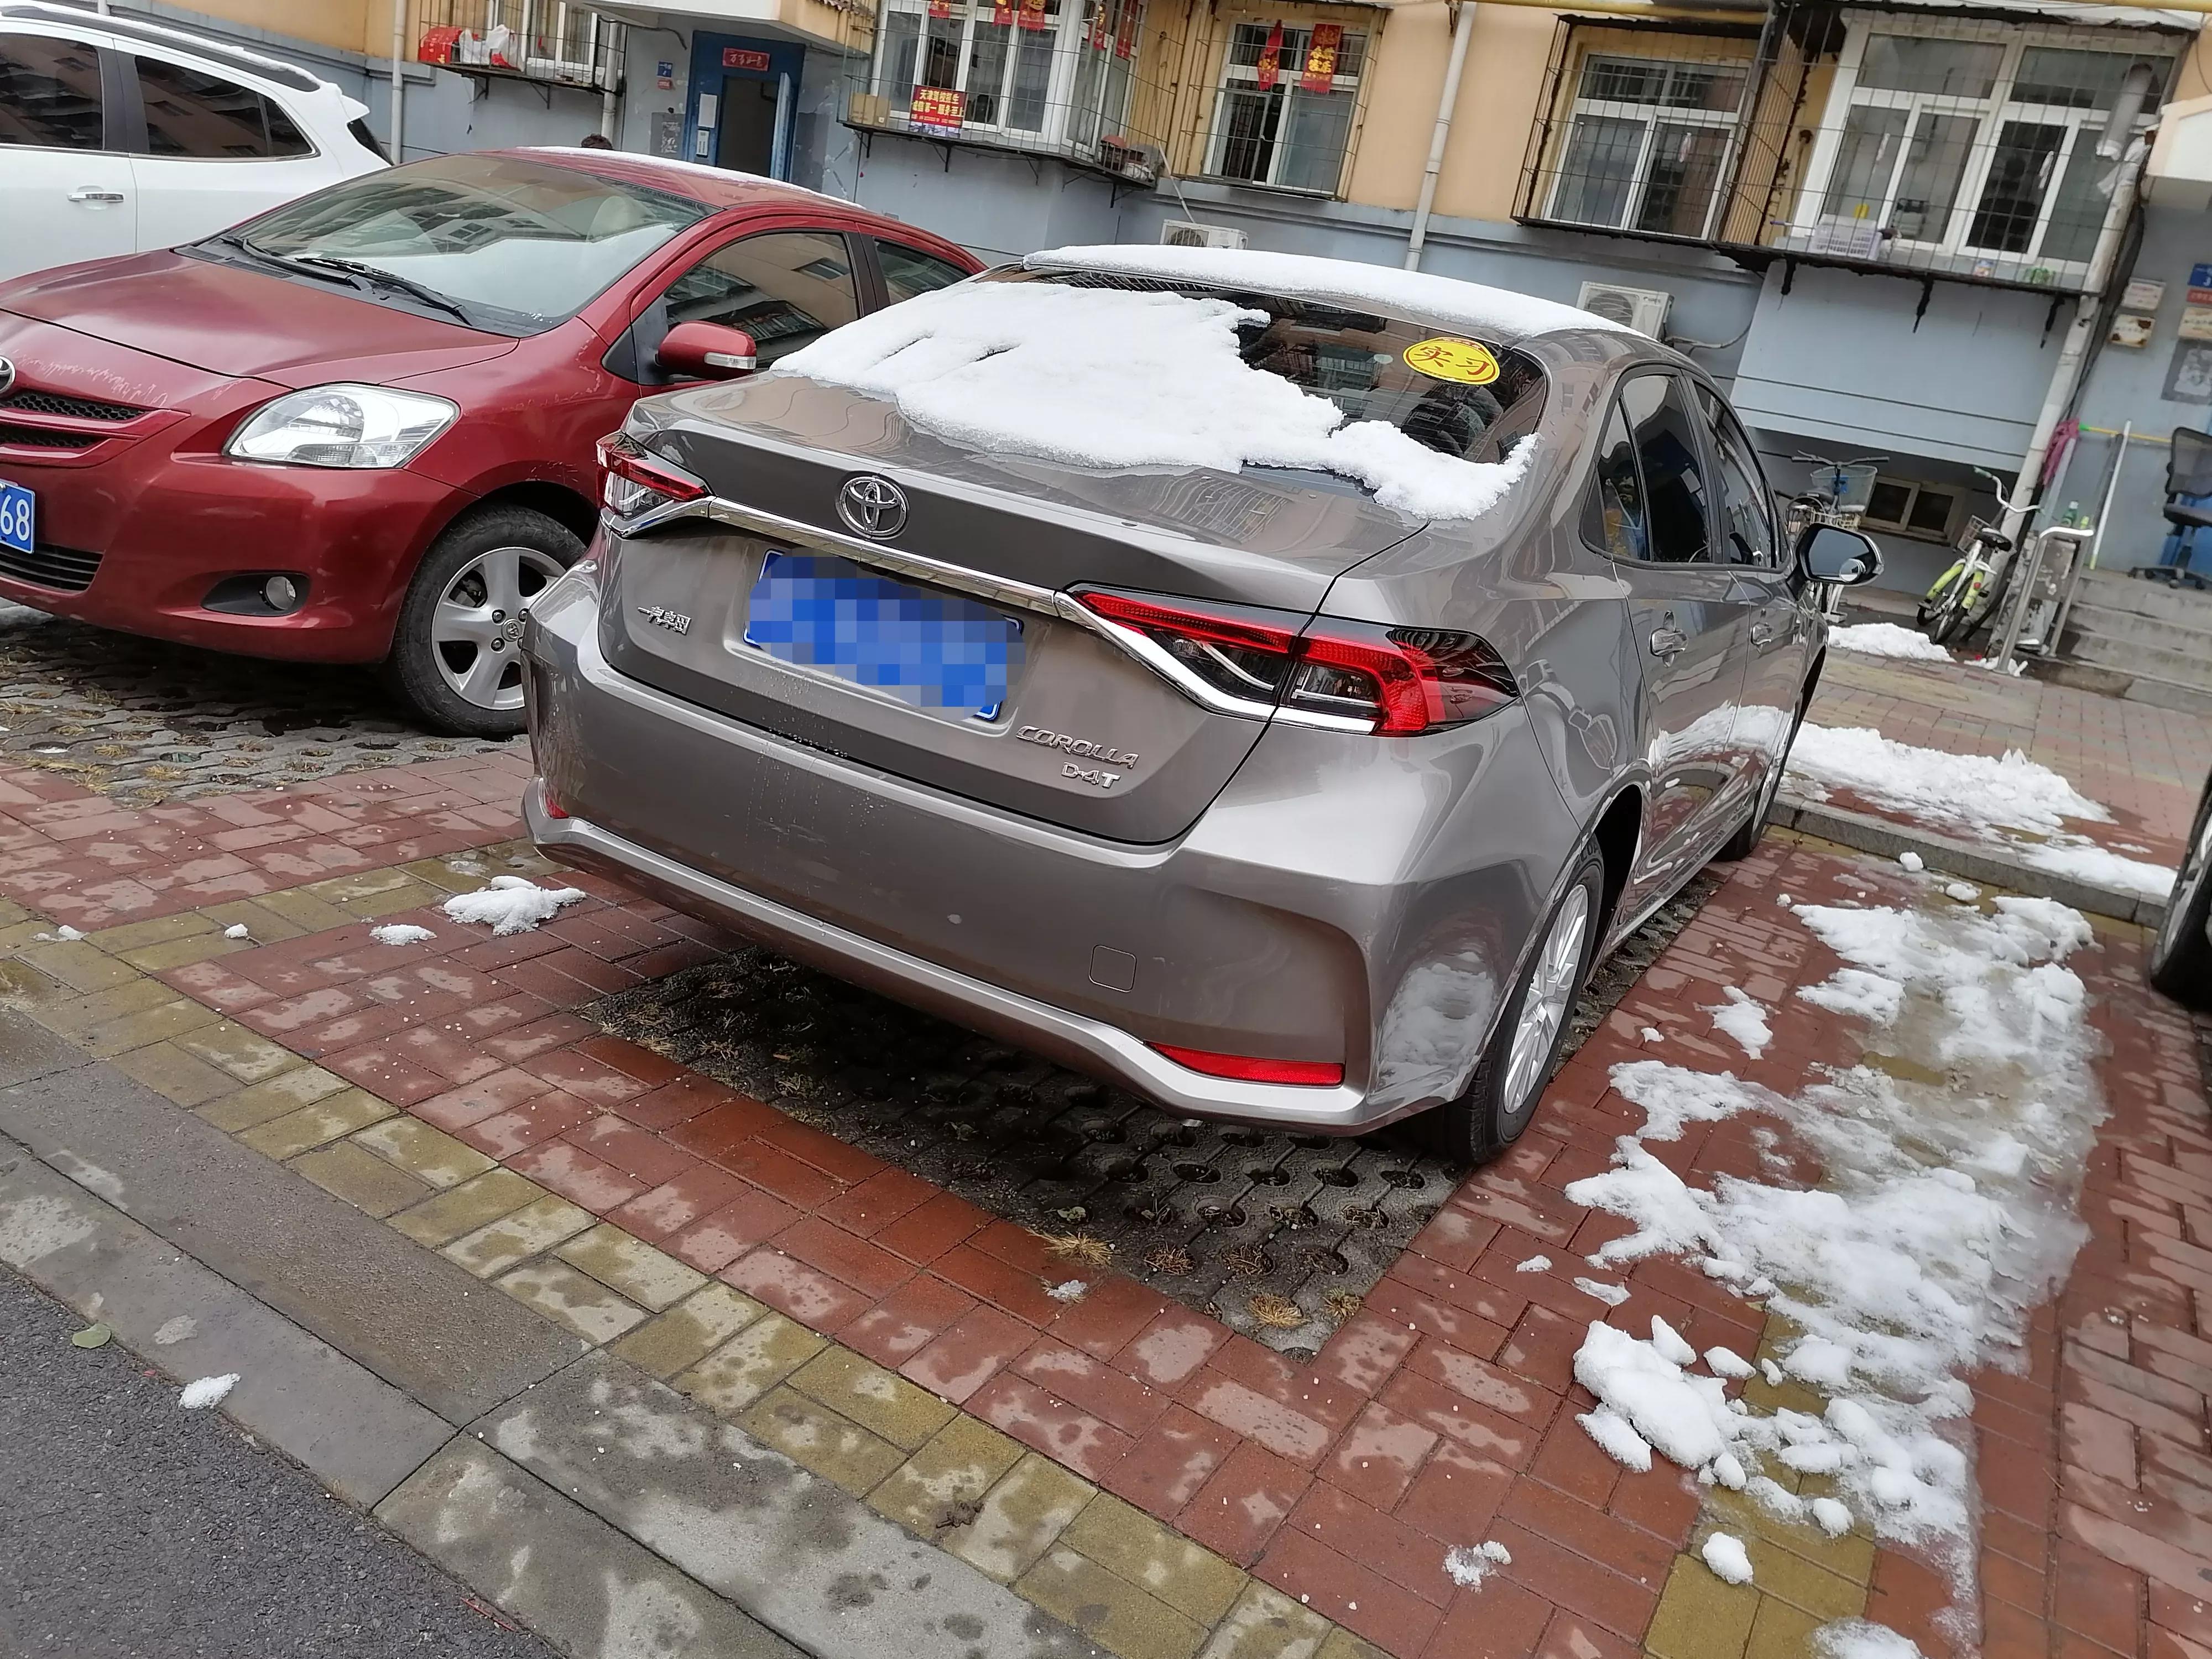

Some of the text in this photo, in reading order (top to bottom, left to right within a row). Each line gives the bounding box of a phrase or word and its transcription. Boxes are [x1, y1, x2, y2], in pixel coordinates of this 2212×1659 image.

[1411, 345, 1490, 375] 实习
[1, 494, 30, 541] 68
[1015, 725, 1139, 769] COROLLA
